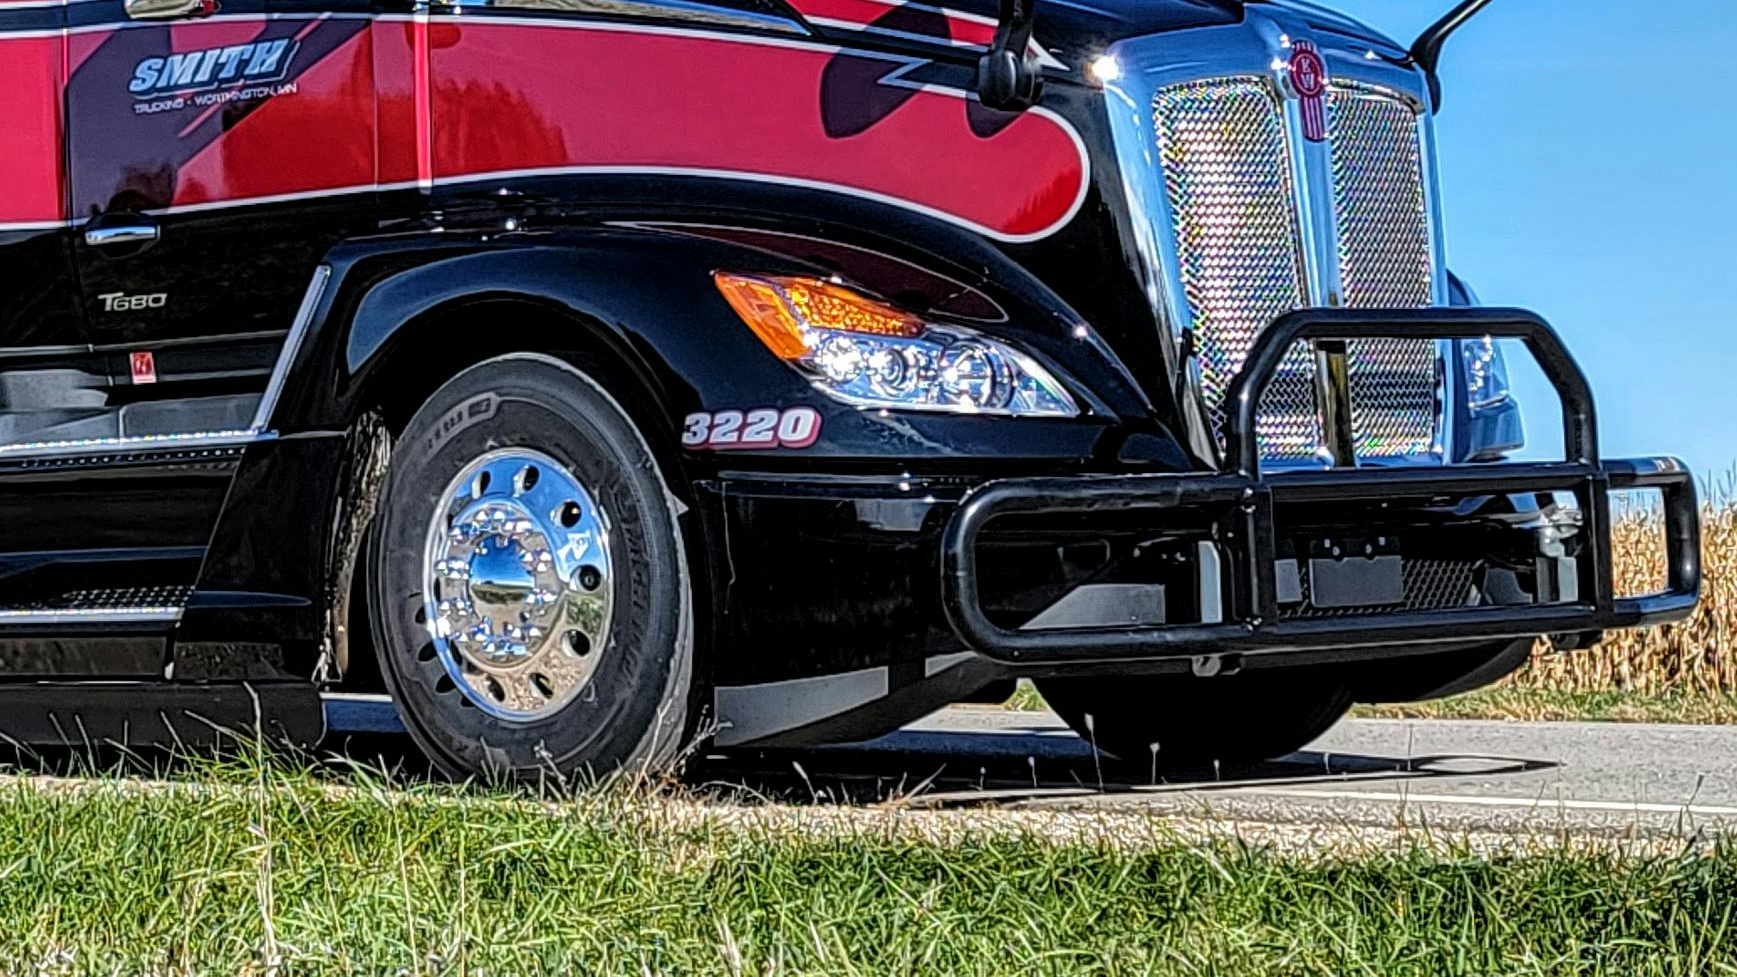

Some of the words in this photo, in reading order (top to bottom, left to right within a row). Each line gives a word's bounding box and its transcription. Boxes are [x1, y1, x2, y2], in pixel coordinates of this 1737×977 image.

[129, 38, 294, 95] SMITH
[133, 98, 184, 114] TRUCKING
[97, 292, 168, 312] T680
[681, 405, 821, 449] 3220
